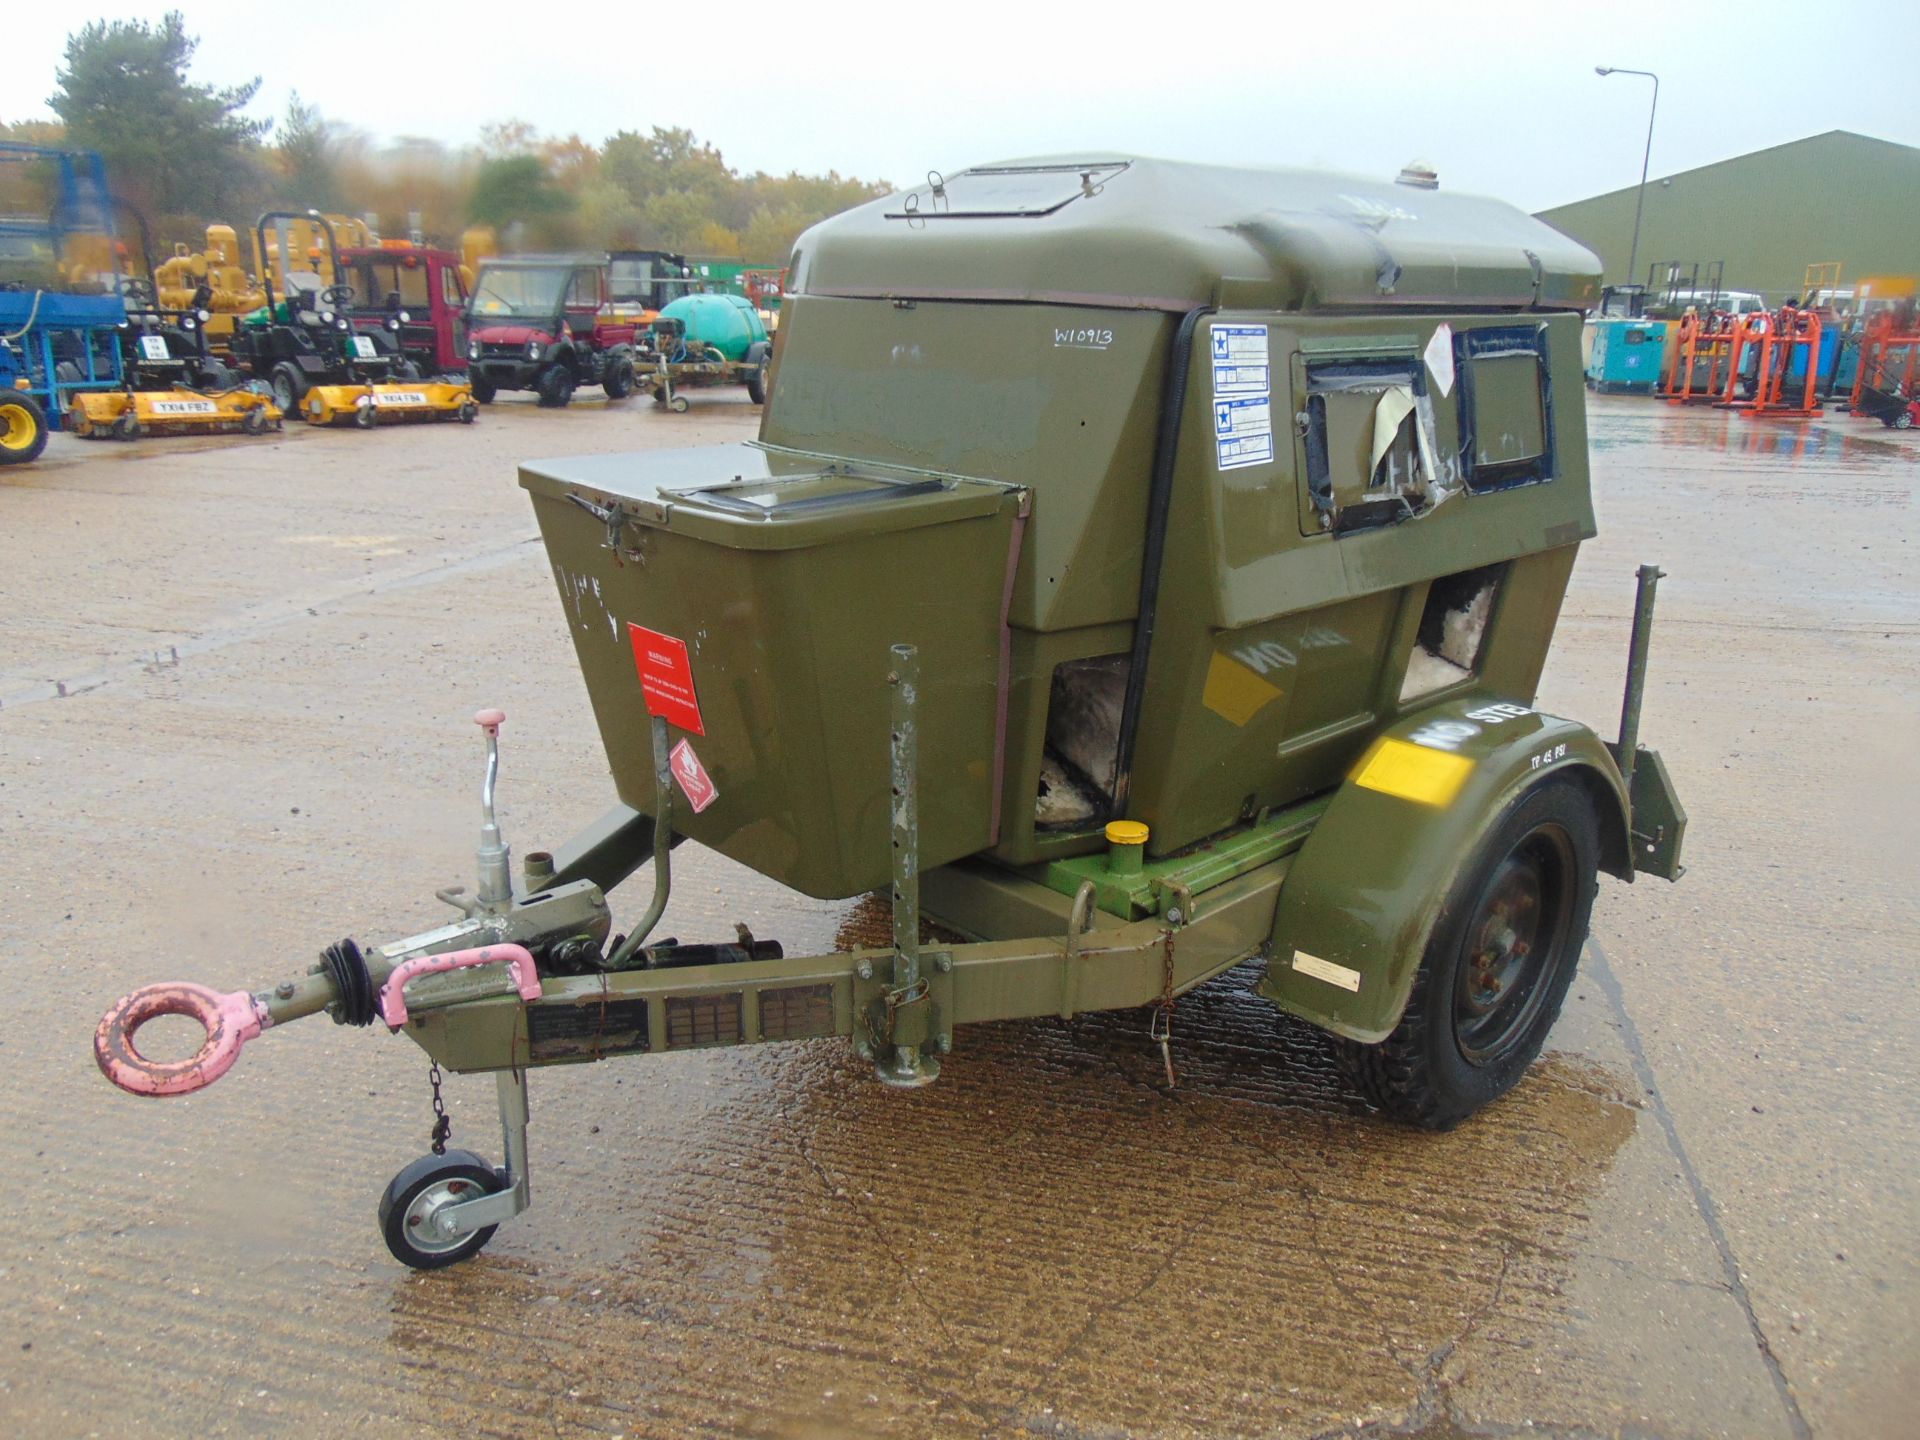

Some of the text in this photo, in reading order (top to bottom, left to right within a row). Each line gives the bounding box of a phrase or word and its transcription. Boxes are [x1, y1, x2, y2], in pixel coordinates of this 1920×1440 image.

[1055, 328, 1113, 345] W10913
[160, 402, 210, 412] YX14 FBZ
[1543, 749, 1552, 764] 45
[1555, 743, 1566, 759] PSI
